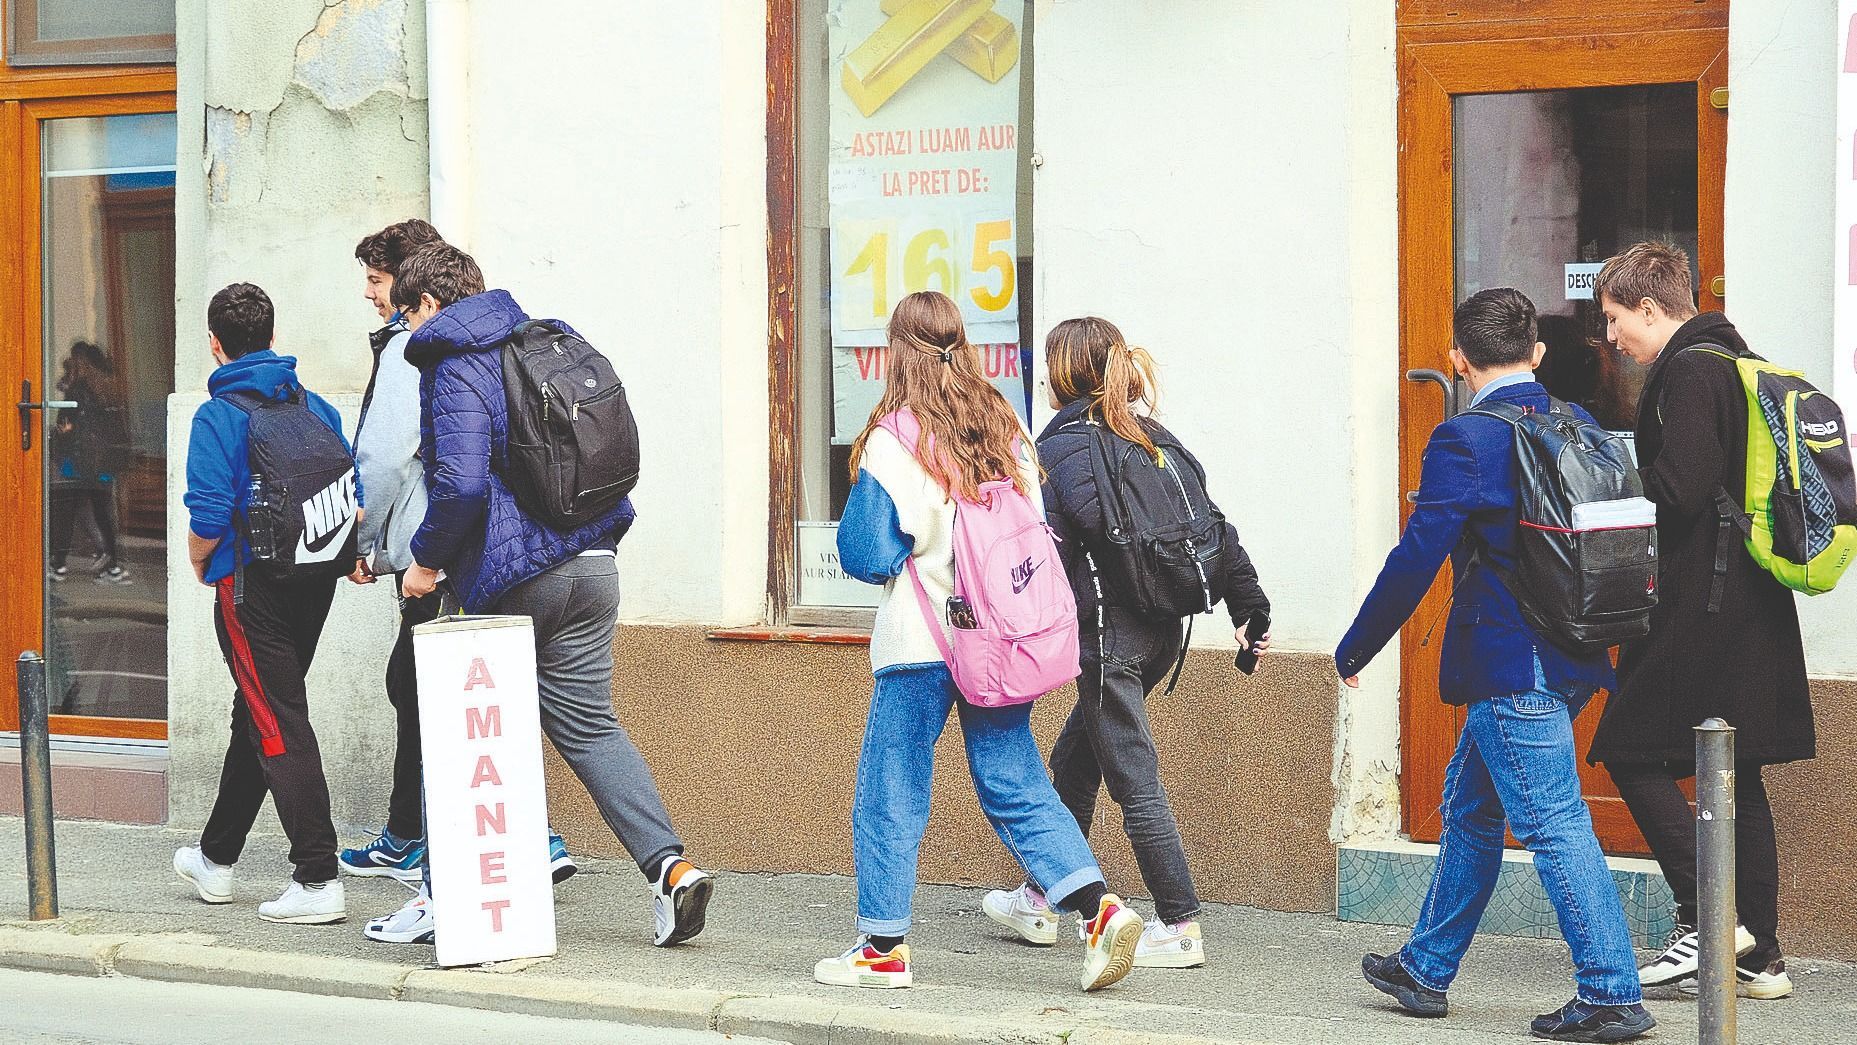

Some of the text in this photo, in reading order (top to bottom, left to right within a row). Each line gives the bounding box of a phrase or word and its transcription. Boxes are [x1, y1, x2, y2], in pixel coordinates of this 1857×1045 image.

[851, 125, 1015, 157] ASTAZI LUAM AUR
[882, 171, 902, 197] LA
[908, 170, 950, 196] PRET
[958, 168, 989, 193] DE:
[985, 343, 1018, 379] UR
[1800, 420, 1839, 436] HEAD
[302, 466, 357, 546] NIKE
[805, 567, 824, 579] AUR
[1011, 555, 1032, 583] NIKE
[464, 657, 511, 933] AMANET
